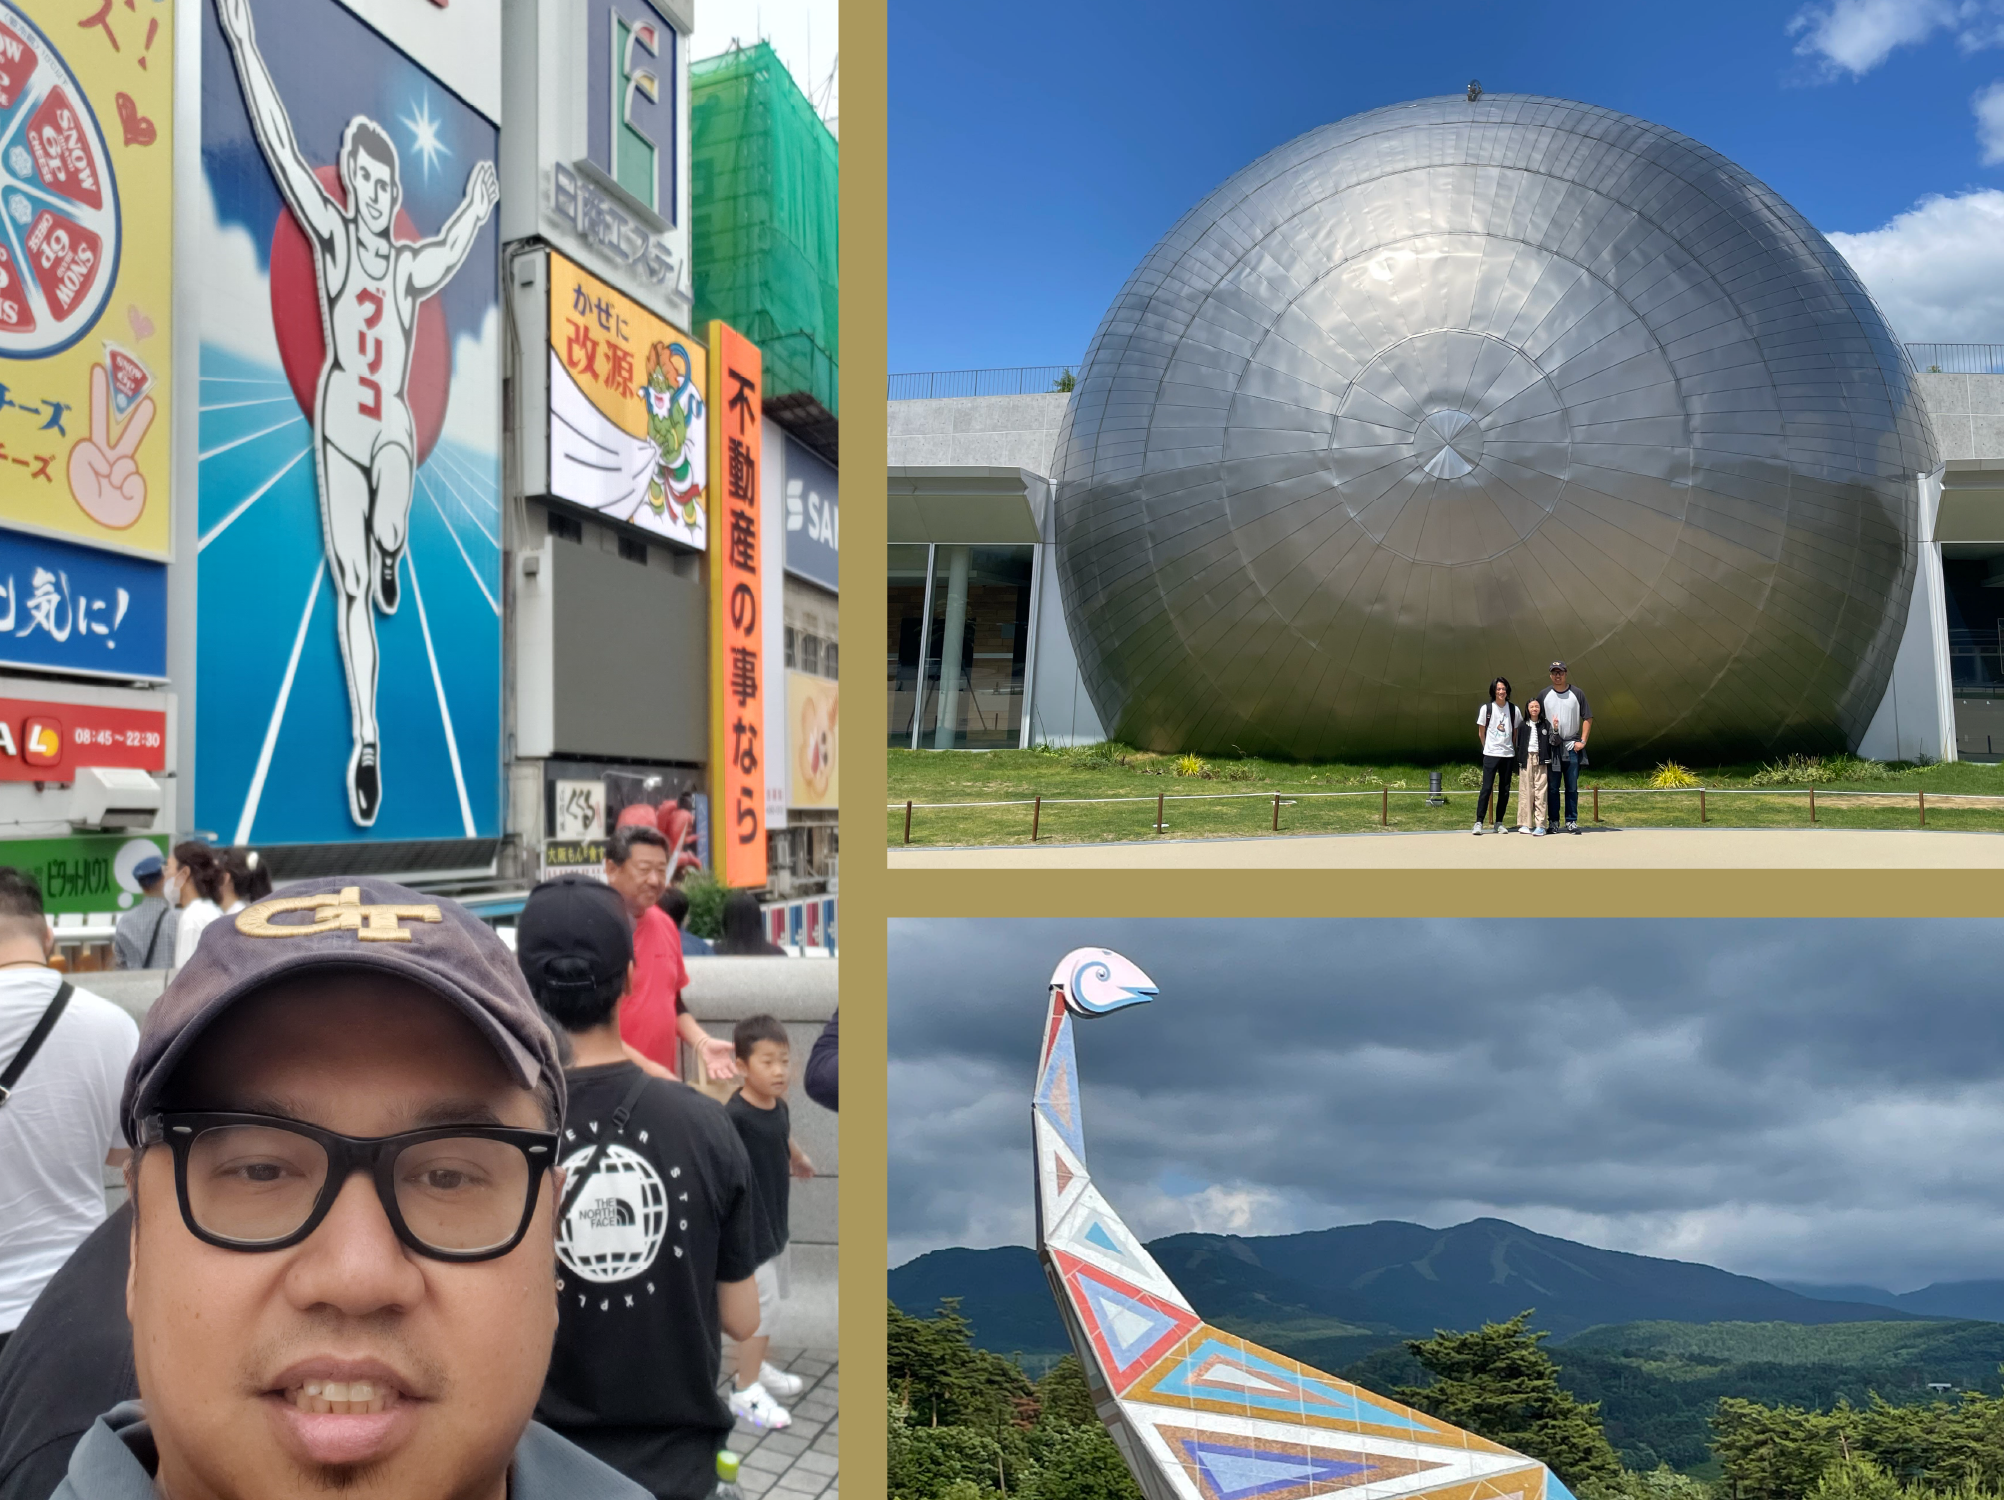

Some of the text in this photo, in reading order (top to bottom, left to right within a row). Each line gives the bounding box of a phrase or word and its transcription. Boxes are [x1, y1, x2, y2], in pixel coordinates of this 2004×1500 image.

[29, 131, 53, 183] CHEESE
[42, 125, 66, 182] 6P
[56, 109, 97, 191] SNOW
[40, 229, 69, 269] 6P
[55, 243, 94, 310] SNOW
[573, 284, 629, 342] かぜに
[116, 356, 142, 379] SNOW
[355, 287, 386, 422] グリコ
[566, 317, 634, 399] 改源
[728, 366, 758, 845] 不動産の事なら
[47, 858, 110, 898] ピタットハウス
[579, 1207, 615, 1220] NORTH
[591, 1217, 616, 1229] FACE
[595, 1198, 615, 1208] THE
